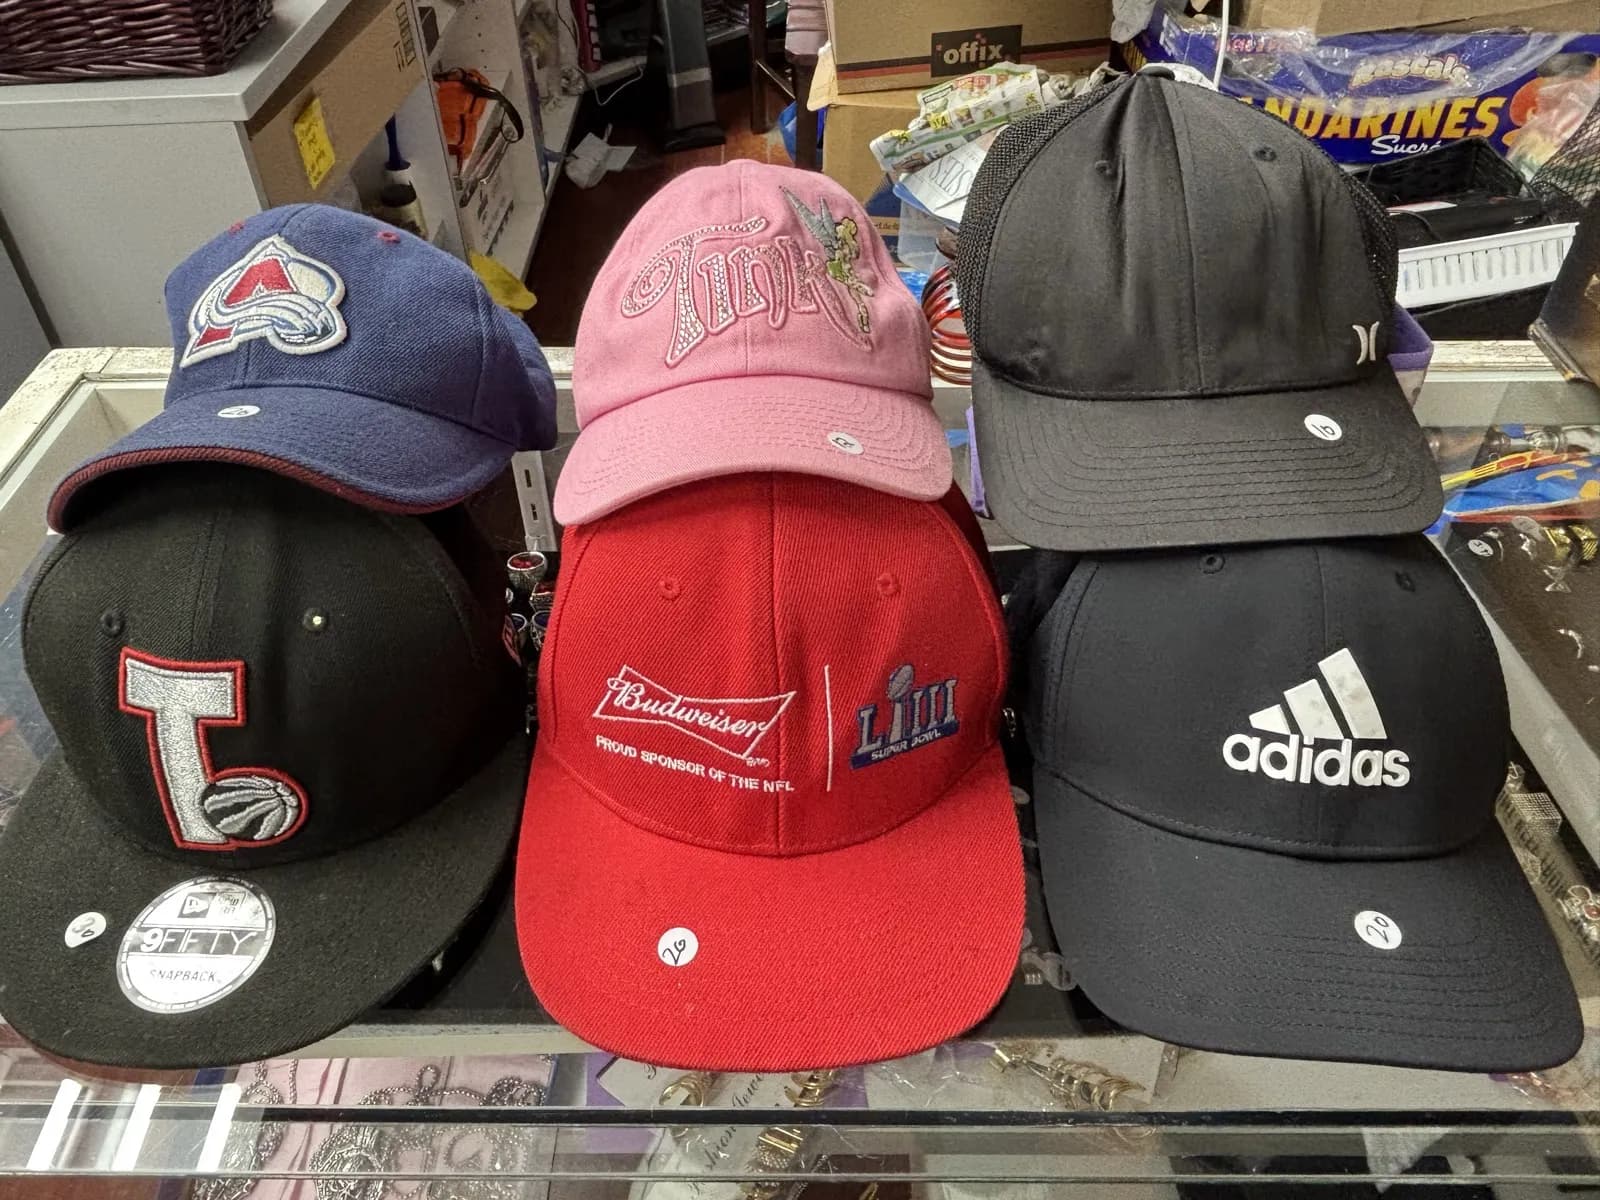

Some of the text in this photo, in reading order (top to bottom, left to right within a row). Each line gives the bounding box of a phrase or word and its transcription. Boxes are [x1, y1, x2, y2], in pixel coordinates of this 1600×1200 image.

[943, 40, 1004, 65] offix
[1238, 95, 1507, 140] NDARINES
[620, 215, 873, 368] Tink
[606, 677, 768, 738] Budweiser
[595, 734, 795, 793] PROUD SPONSOR OF THE NFL
[1222, 733, 1411, 788] adidas
[139, 927, 258, 955] 9FIFTY
[1365, 916, 1390, 944] 20
[150, 968, 218, 983] SNAPBACK
